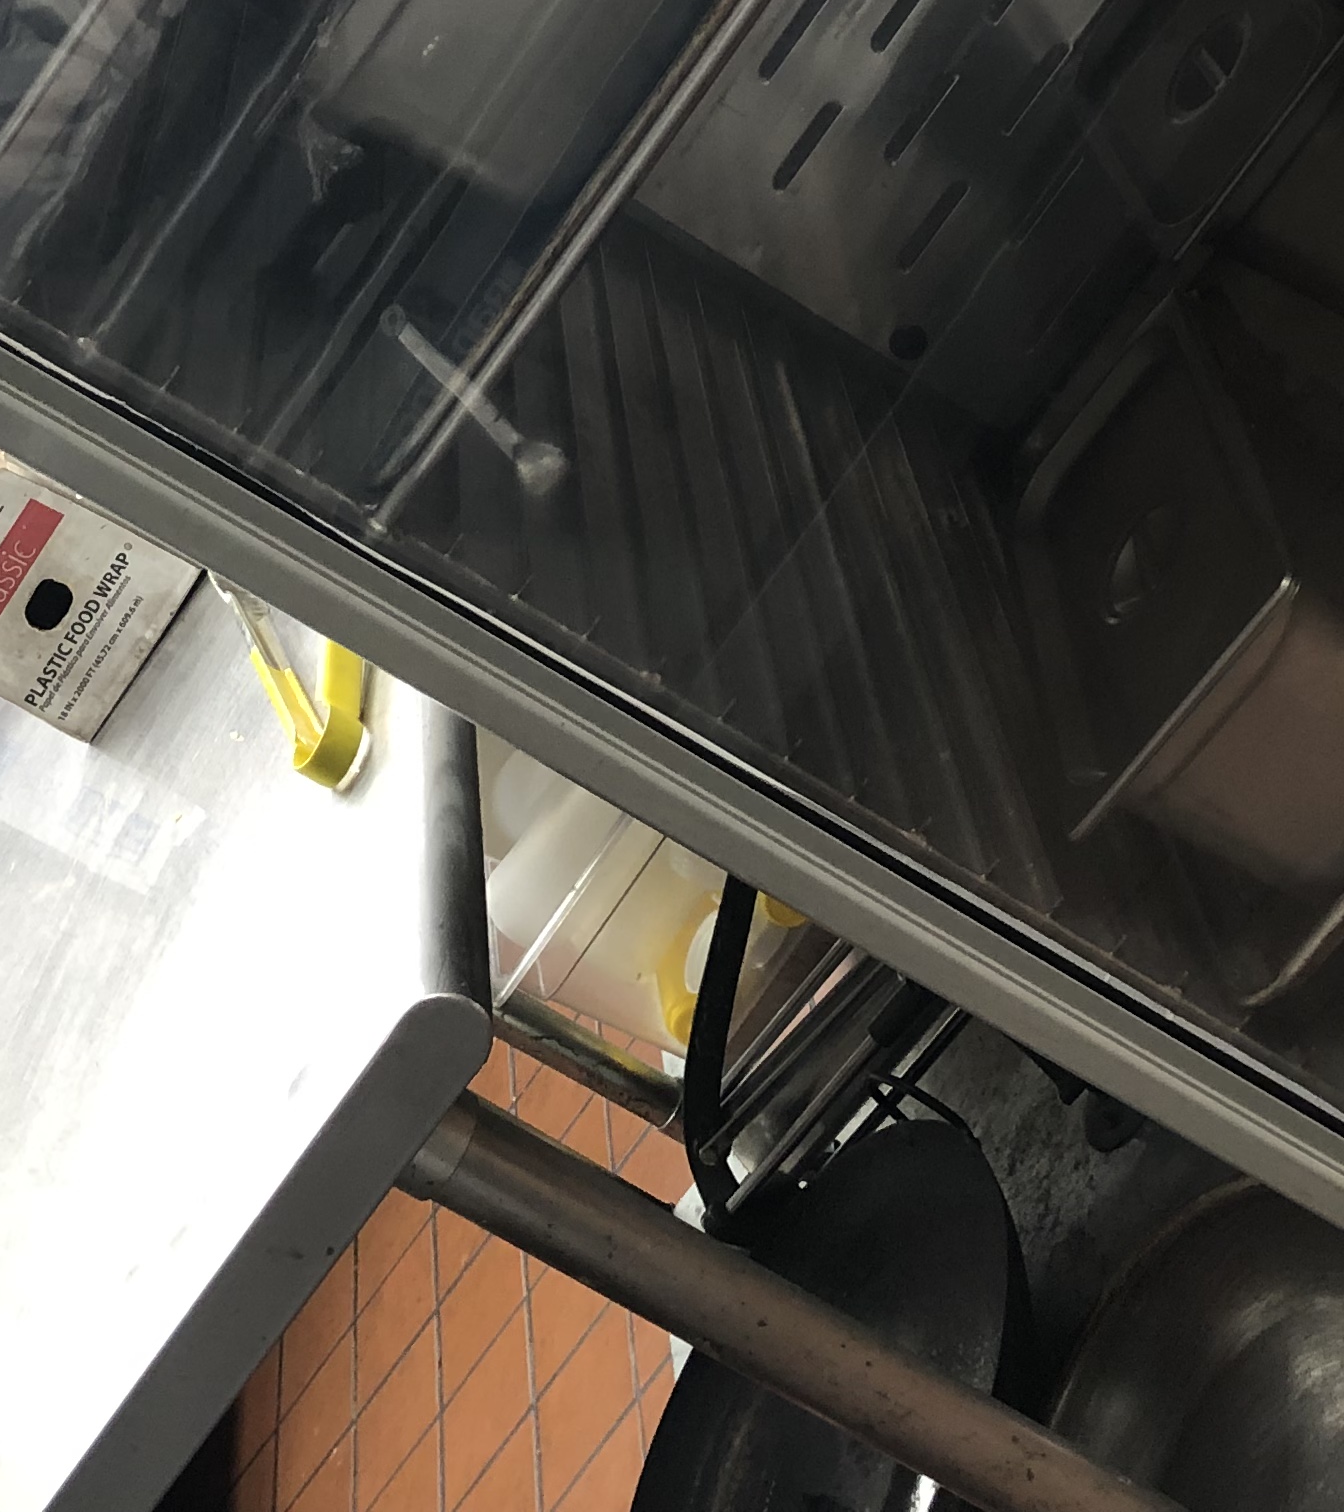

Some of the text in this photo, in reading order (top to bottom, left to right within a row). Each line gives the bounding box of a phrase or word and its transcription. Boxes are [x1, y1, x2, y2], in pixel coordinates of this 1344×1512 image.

[25, 553, 128, 706] PLASTIC FOOD WRAP
[39, 690, 55, 712] Papel
[53, 682, 61, 692] de
[76, 639, 89, 657] para
[86, 610, 107, 640] Envolver
[106, 576, 130, 610] Alimentos
[58, 711, 68, 720] 18
[64, 702, 74, 711] IN
[74, 677, 89, 696] 2000
[85, 667, 95, 678] FT
[92, 644, 111, 668] (45.72
[109, 634, 118, 645] cm
